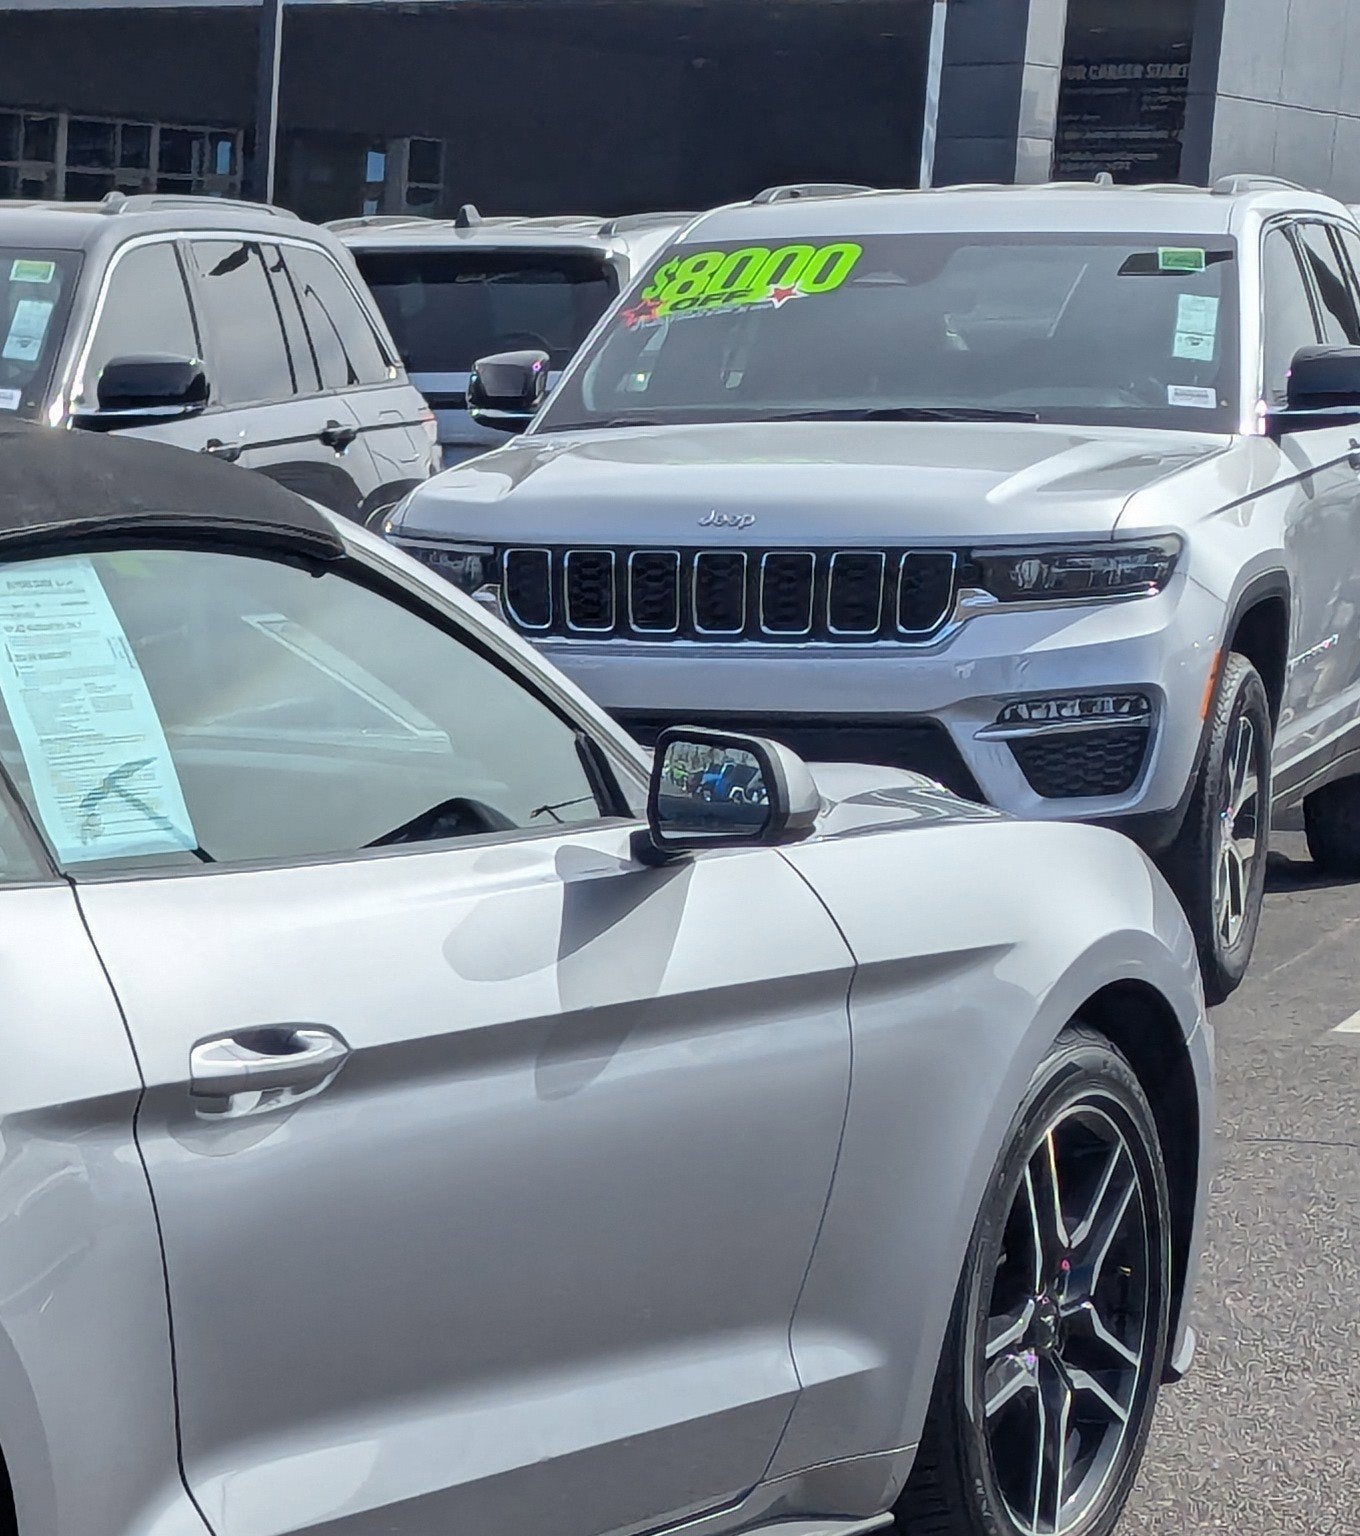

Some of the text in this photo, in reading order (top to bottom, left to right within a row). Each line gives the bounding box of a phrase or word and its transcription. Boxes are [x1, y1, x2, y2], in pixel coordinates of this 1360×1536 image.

[641, 243, 863, 301] $8000
[669, 288, 755, 311] OFF
[698, 509, 756, 530] Jeep
